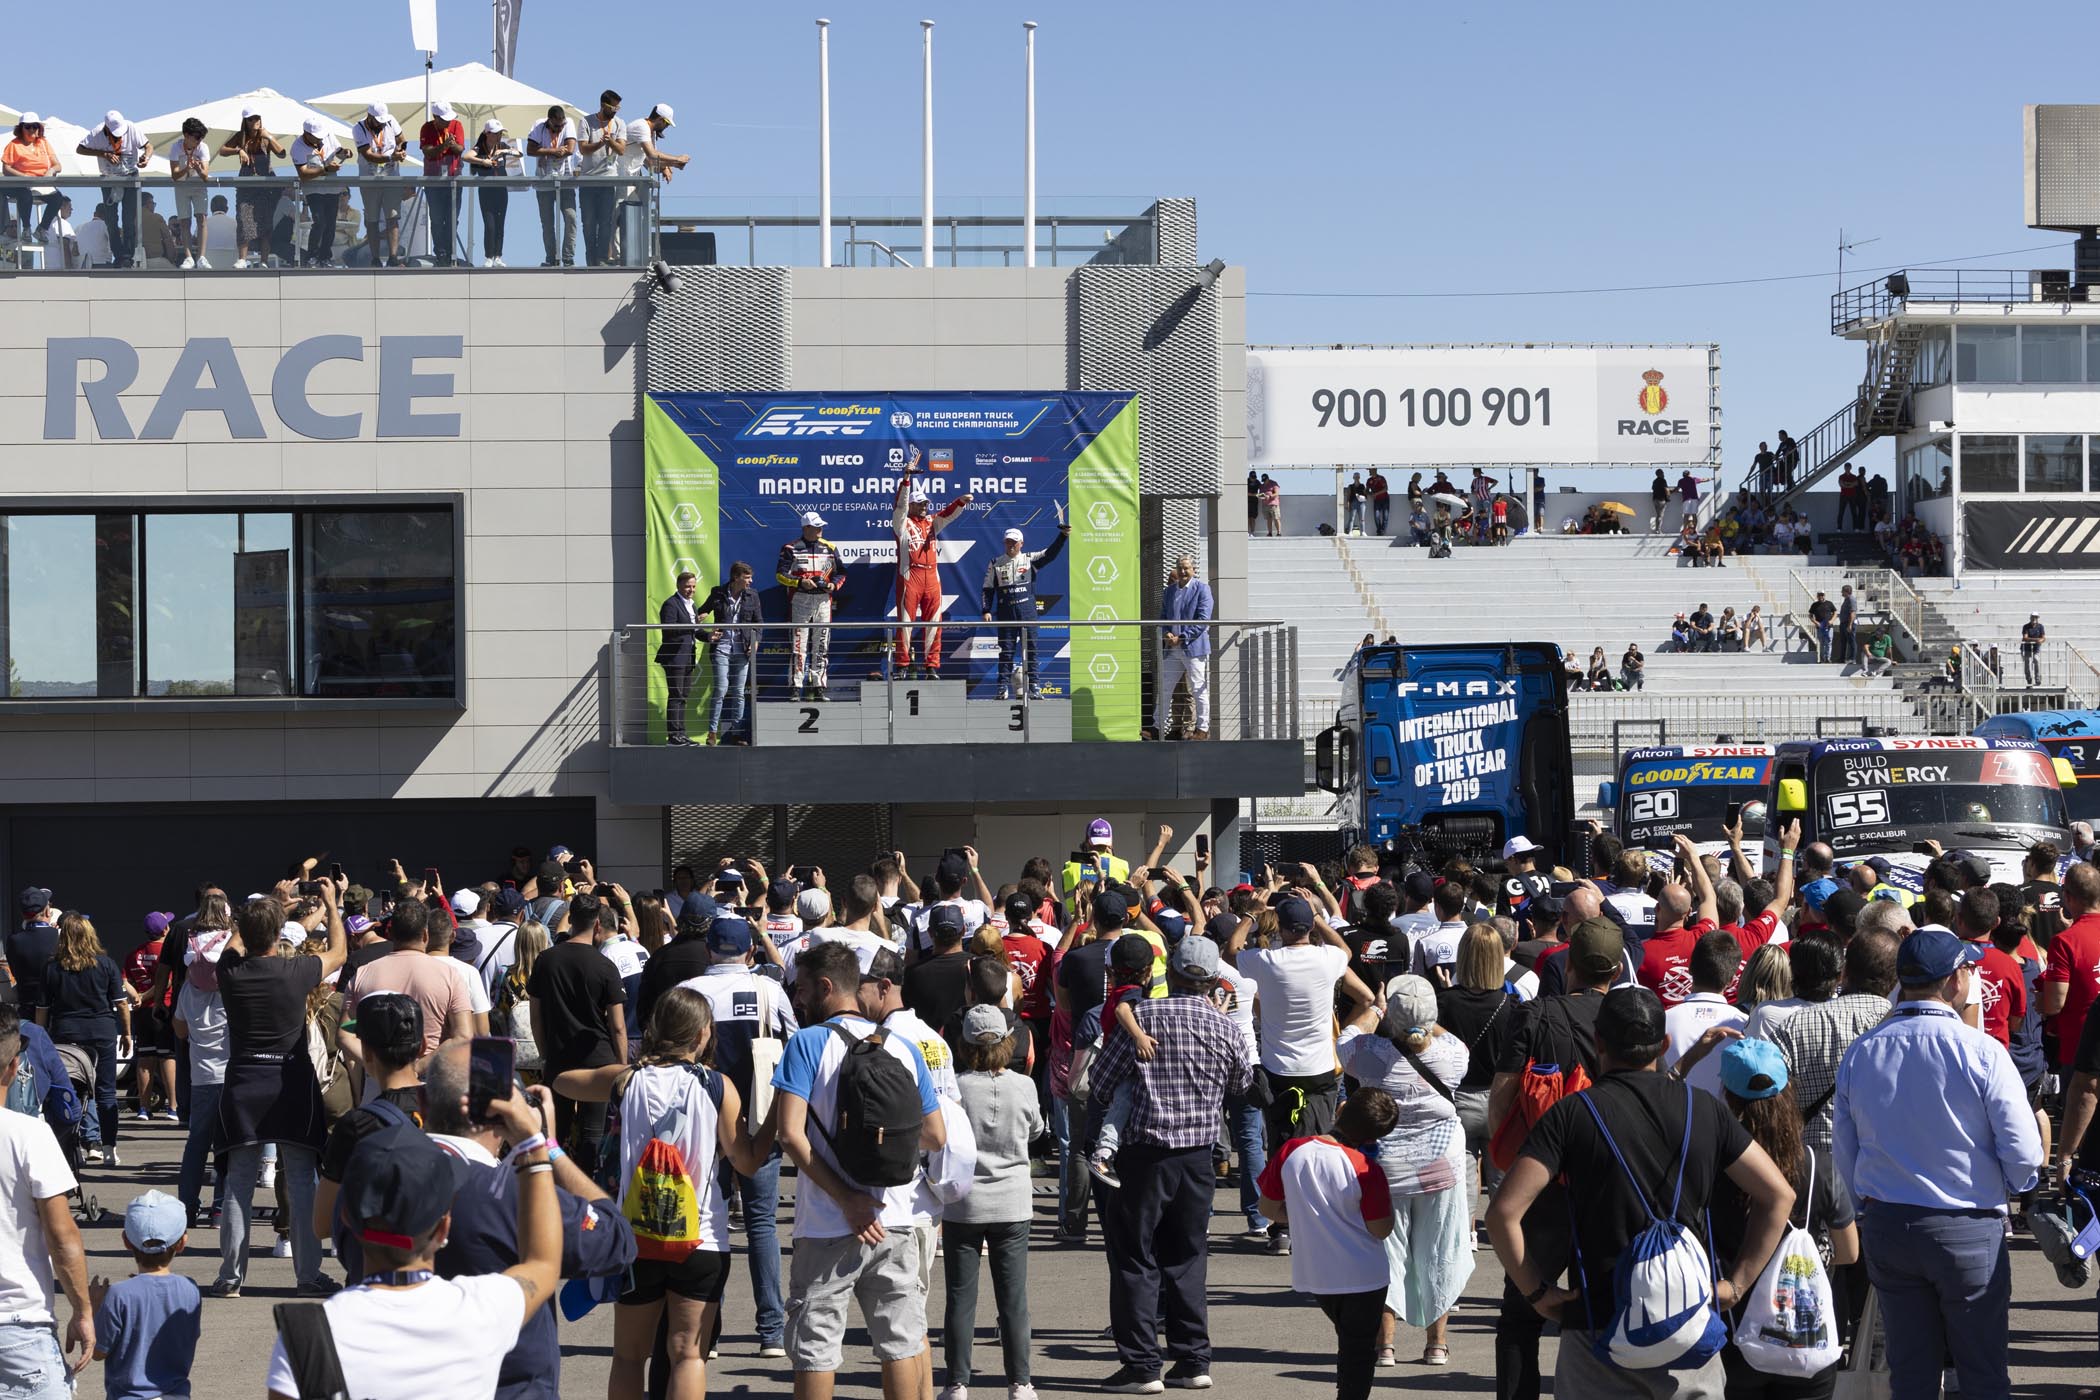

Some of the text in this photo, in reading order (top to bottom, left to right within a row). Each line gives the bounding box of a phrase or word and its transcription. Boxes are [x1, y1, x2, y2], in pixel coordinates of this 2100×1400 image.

[43, 334, 464, 441] RACE
[819, 405, 881, 416] GOODYEAR
[1312, 387, 1551, 428] 900 100 901
[892, 415, 912, 426] FIA
[952, 420, 1019, 428] CHAMPIONSHIP
[1617, 420, 1689, 436] RACE
[737, 454, 799, 466] GOODYEAR
[821, 455, 864, 466] IVECO
[759, 478, 845, 494] MADRID
[970, 478, 1028, 493] RACE
[795, 501, 893, 511] XXXV GP DE ESPAÑA FIA
[1398, 680, 1517, 697] F-MAX
[906, 690, 920, 716] 1
[798, 707, 820, 734] 2
[1008, 704, 1025, 732] 3
[1399, 698, 1519, 743] INTERNATIONAL
[1434, 729, 1484, 760] TRUCK
[1825, 739, 2035, 752] Altron SYNER Altron
[1632, 747, 1767, 760] Altron SYNER
[1414, 748, 1507, 787] OF THE YEAR
[1843, 756, 1887, 770] BUILD
[1630, 762, 1756, 785] GOODYEAR
[1441, 777, 1480, 806] 2019
[1633, 791, 1676, 820] 20
[1831, 792, 1886, 827] 55
[1653, 823, 1693, 832] EXCALIBUR
[1860, 830, 1907, 840] EXCALIBUR
